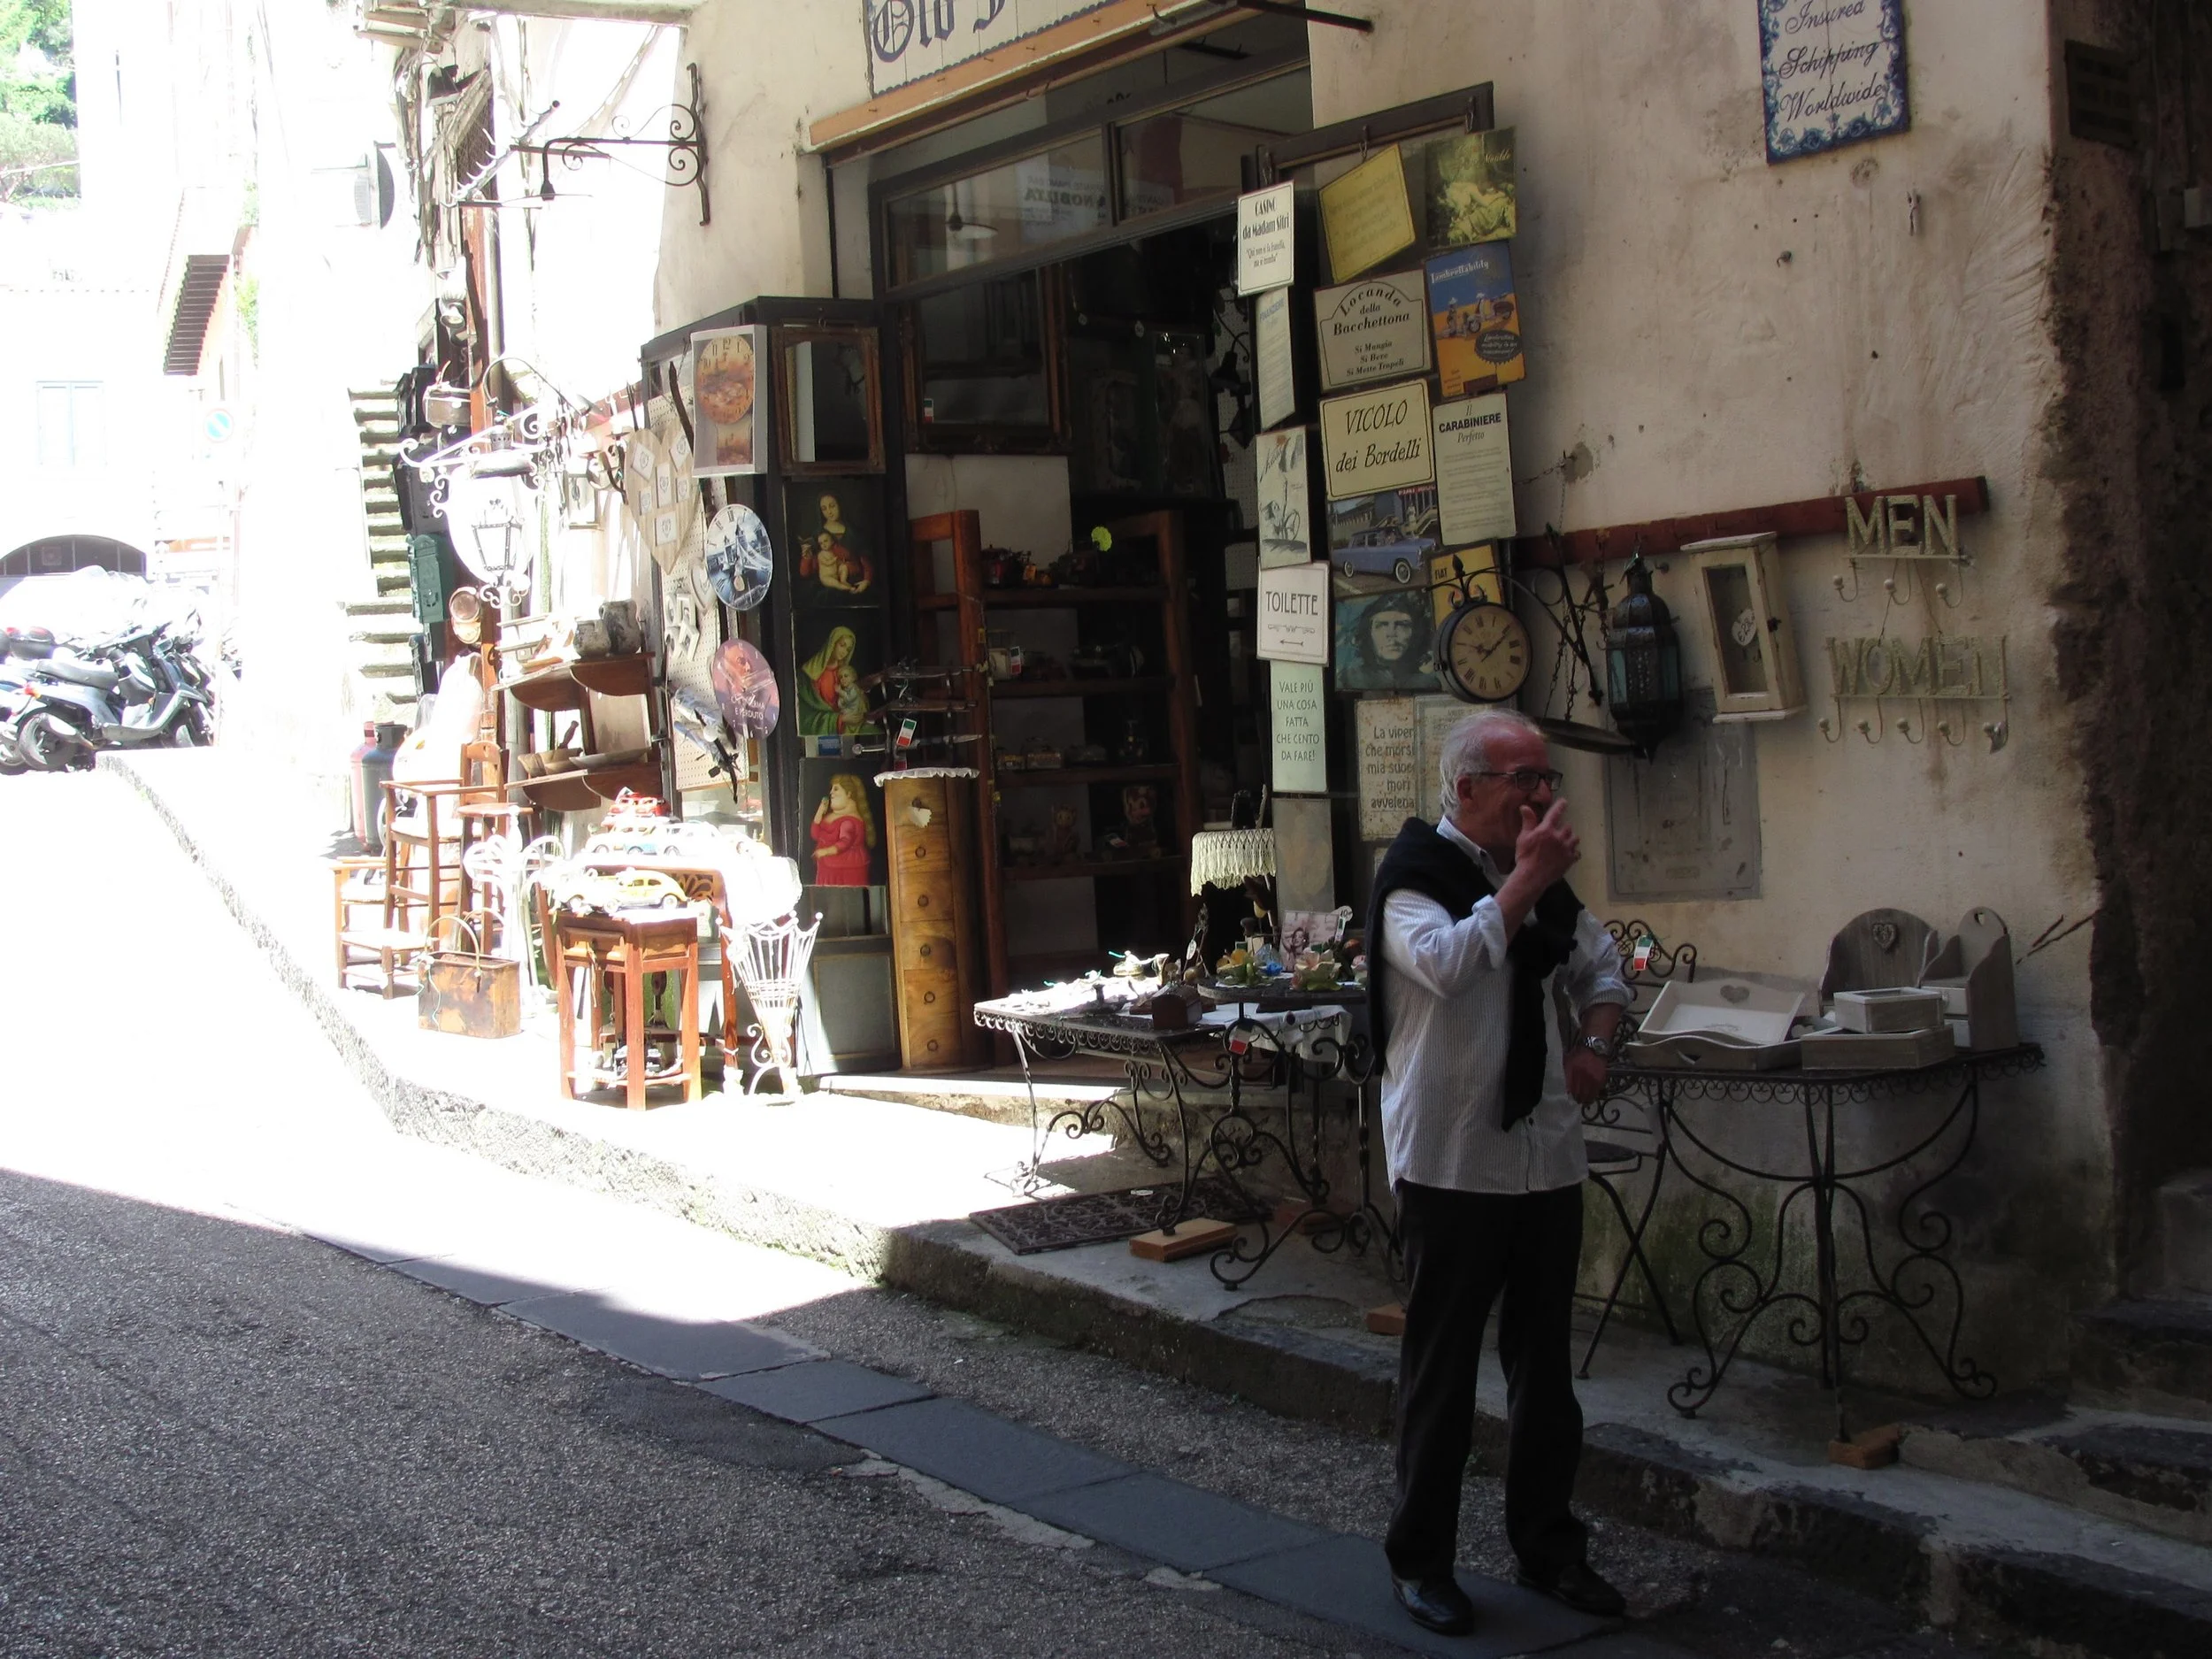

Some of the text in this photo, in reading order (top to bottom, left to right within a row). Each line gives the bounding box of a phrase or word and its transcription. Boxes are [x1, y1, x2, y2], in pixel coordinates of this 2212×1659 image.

[1785, 0, 1866, 35] Insured
[1780, 72, 1883, 123] Worldwide
[1253, 219, 1276, 237] Madam
[1276, 212, 1289, 232] Sitri
[1339, 288, 1402, 317] Locanda
[1359, 303, 1381, 316] della
[1333, 311, 1410, 337] Bacchettona
[1365, 340, 1394, 353] Mangia
[1371, 351, 1388, 363] Bere
[1345, 398, 1409, 435] VICOLO
[1439, 412, 1502, 434] CARABINIERE
[1456, 430, 1486, 445] Perfetto
[1335, 438, 1422, 473] dei Bordelli
[1845, 494, 1958, 556] MEN
[1434, 567, 1448, 580] FIAT
[1265, 590, 1318, 617] TOILETTE
[1824, 635, 2007, 697] WOMEN
[1279, 680, 1298, 694] VALE
[1277, 698, 1317, 711] UNA COSA
[1286, 715, 1309, 728] FATTA
[1276, 733, 1320, 746] CHE CENTO
[1373, 725, 1415, 740] La viper
[1281, 749, 1316, 762] DA FARE!
[1365, 744, 1383, 757] che
[1367, 763, 1386, 774] mia
[1371, 796, 1416, 809] avvelena
